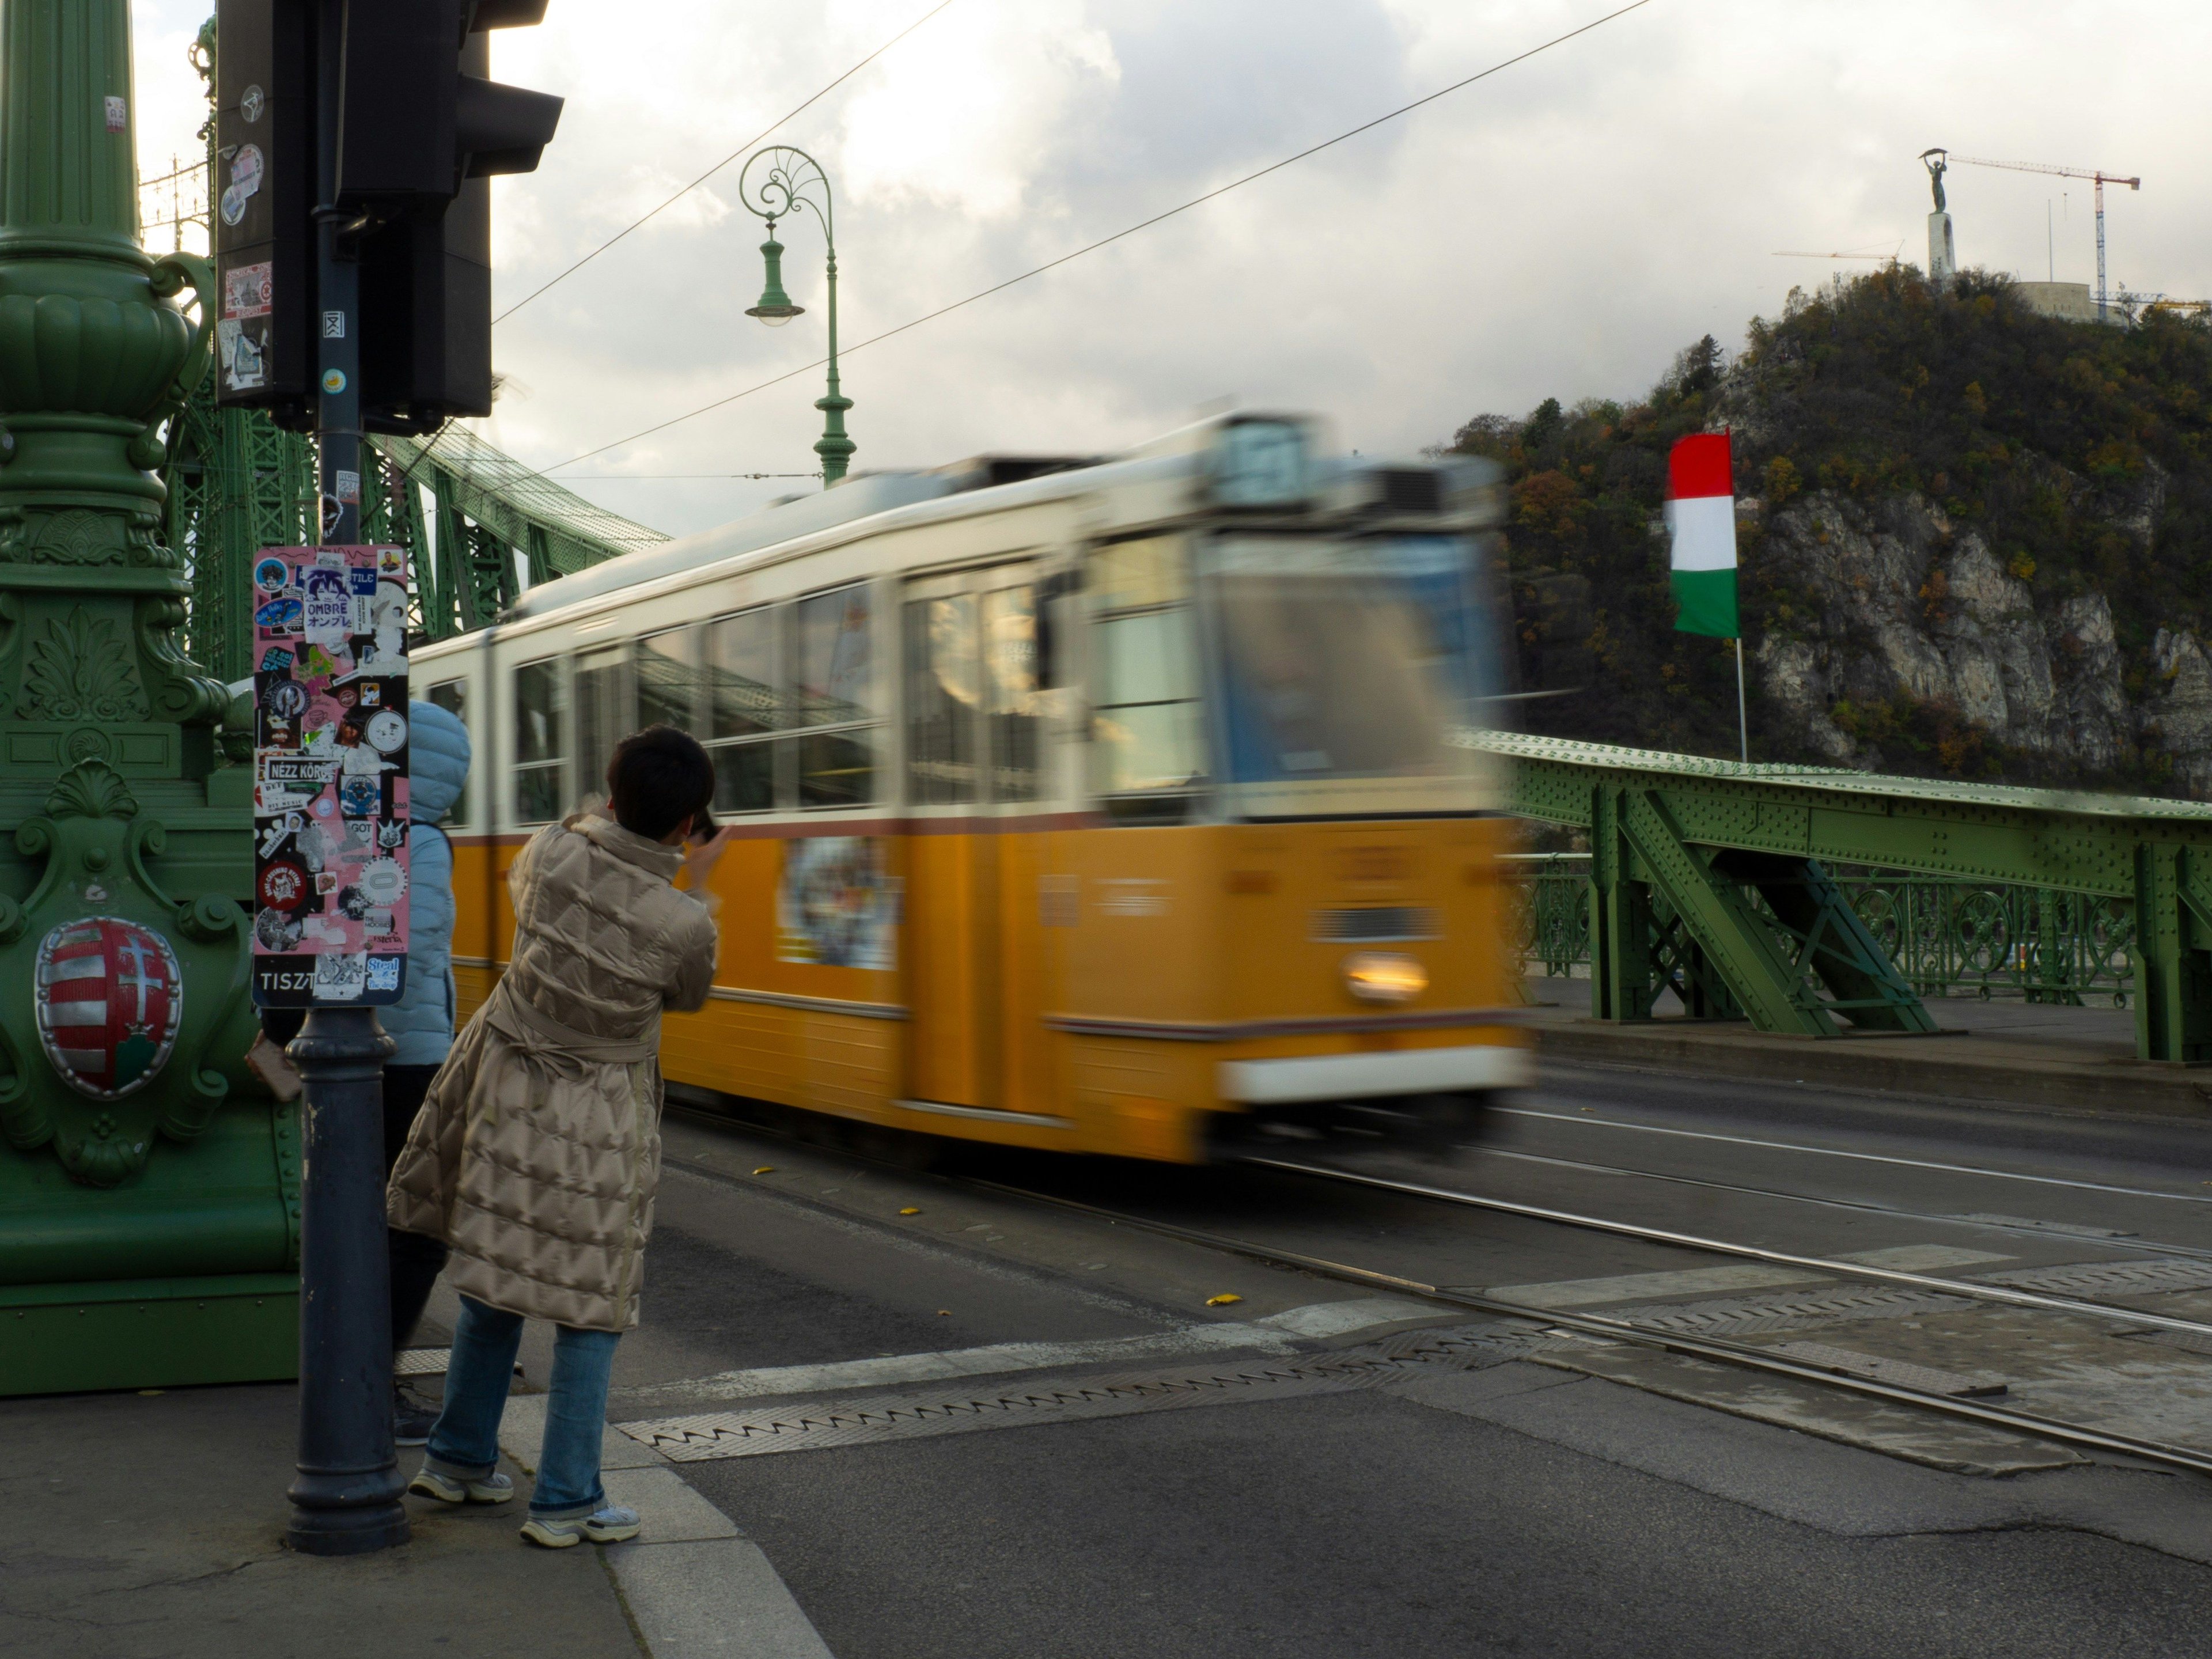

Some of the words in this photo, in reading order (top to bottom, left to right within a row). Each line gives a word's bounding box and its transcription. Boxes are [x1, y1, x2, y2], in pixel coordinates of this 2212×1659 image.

[308, 603, 347, 615] OMBRE
[272, 762, 298, 778] NÉZZ
[266, 782, 282, 791] DEF
[351, 824, 372, 832] GOT
[362, 857, 389, 872] VIENNA
[394, 859, 408, 895] RUNNING
[369, 959, 397, 971] Steal
[260, 973, 315, 990] TISZT
